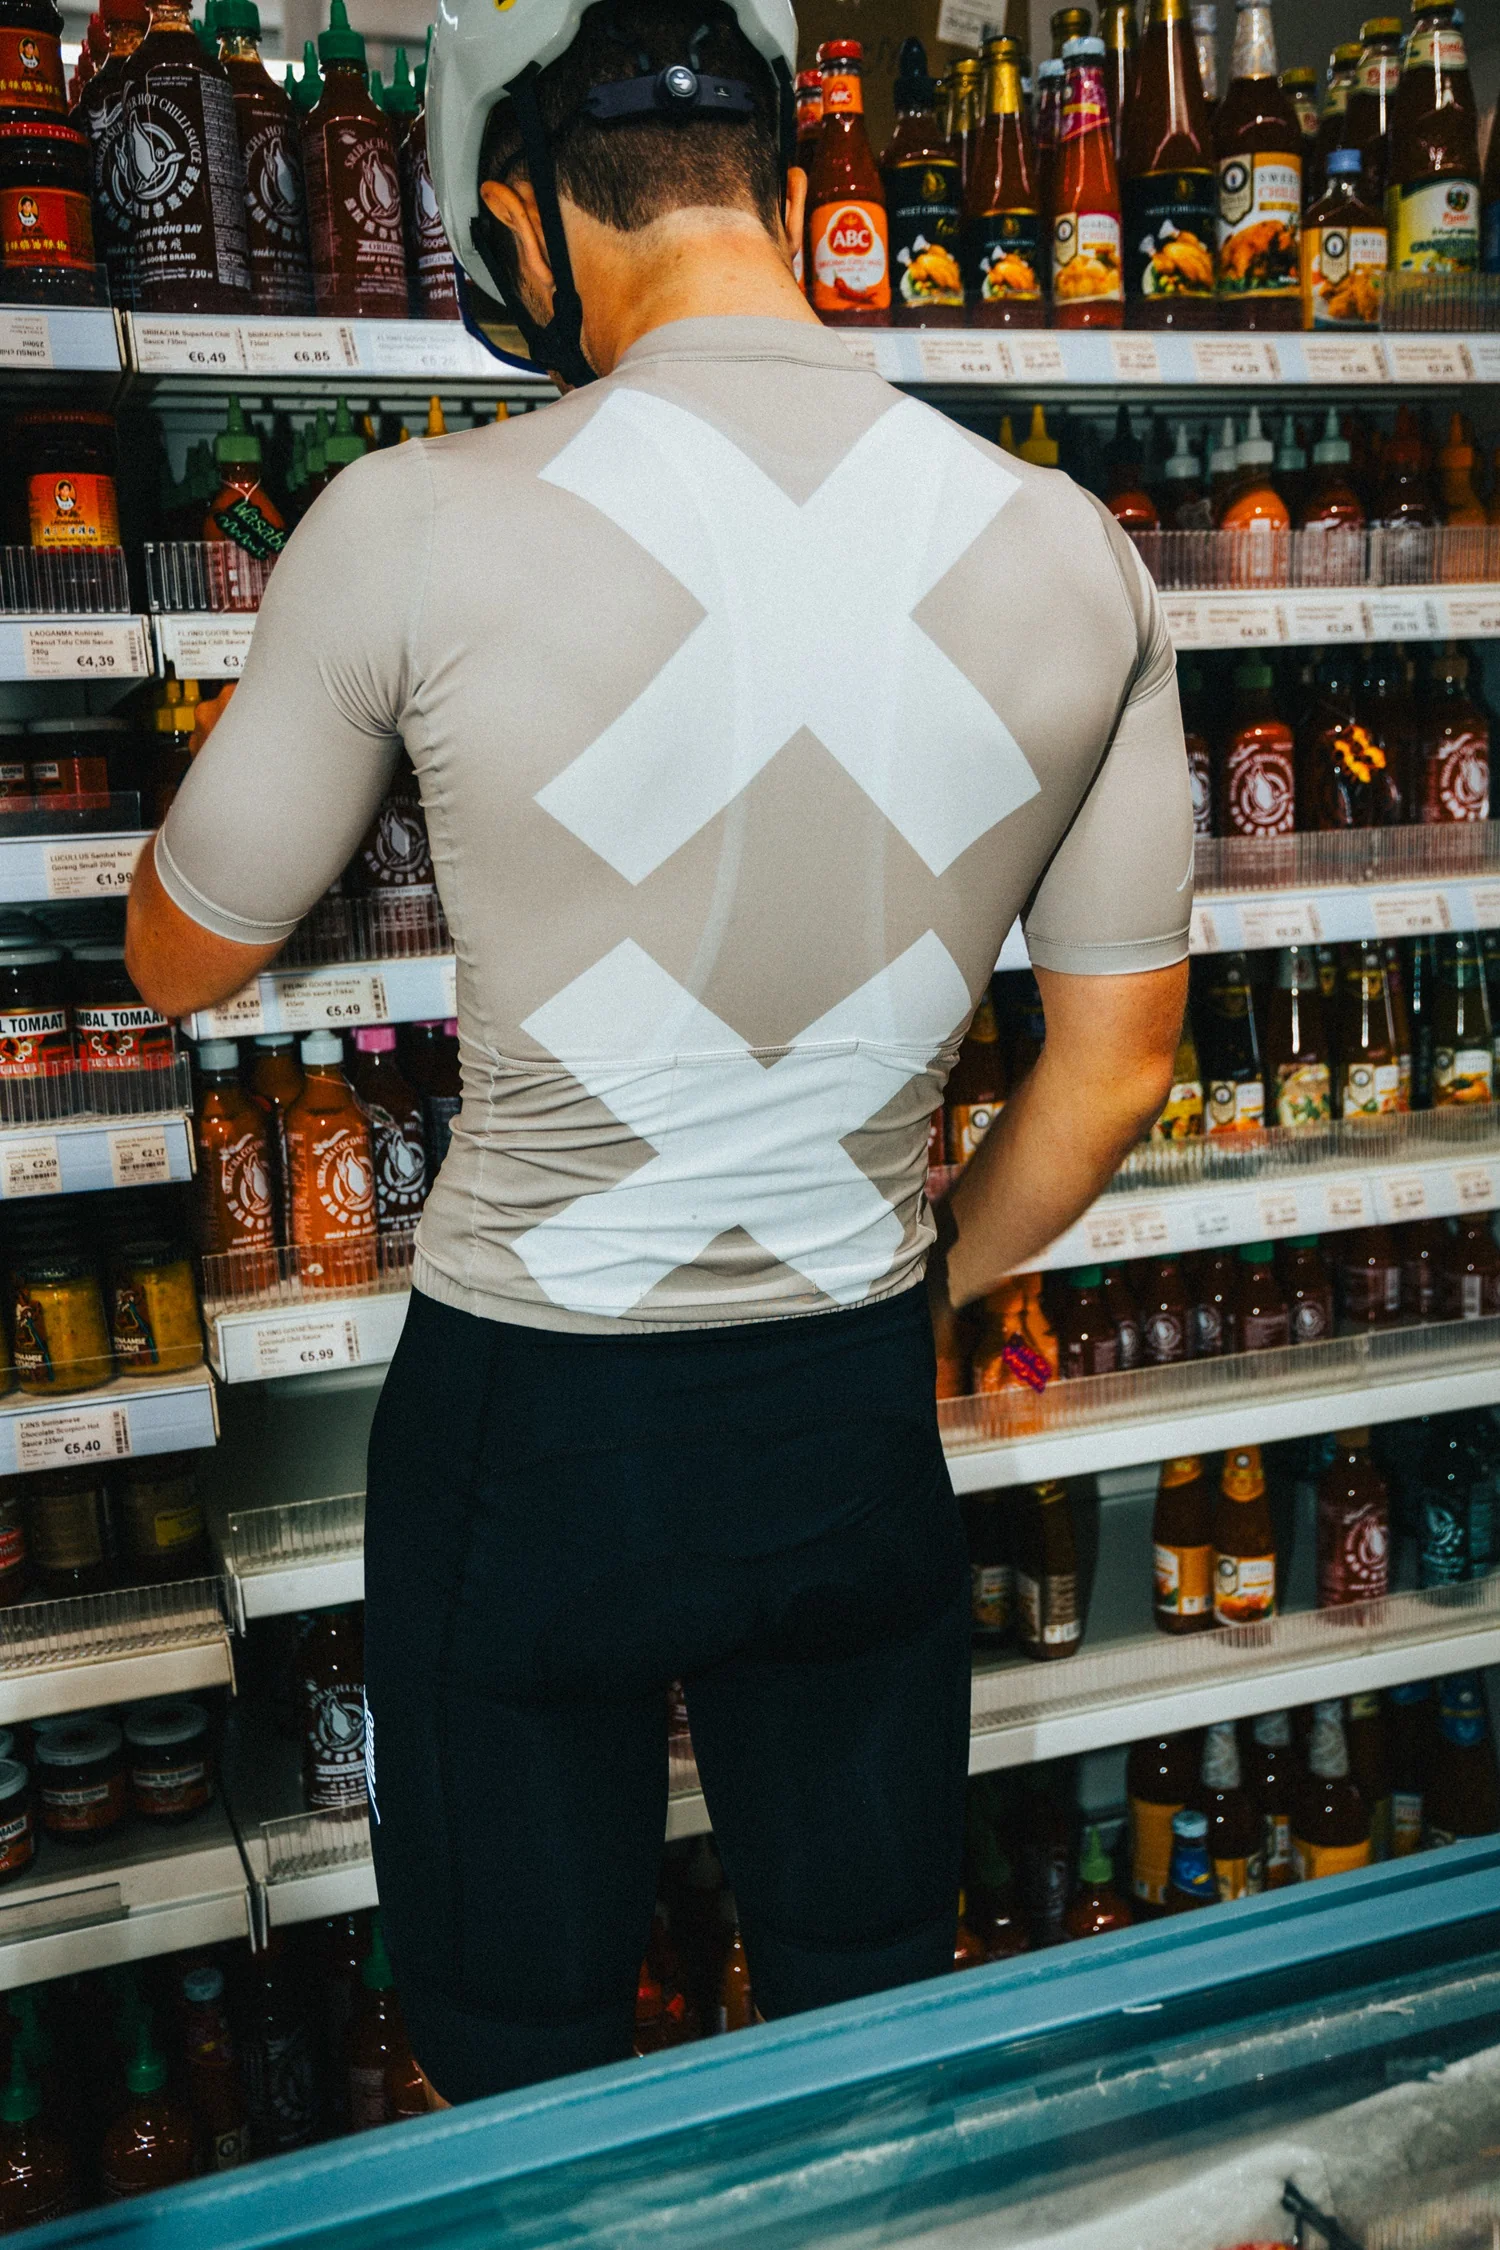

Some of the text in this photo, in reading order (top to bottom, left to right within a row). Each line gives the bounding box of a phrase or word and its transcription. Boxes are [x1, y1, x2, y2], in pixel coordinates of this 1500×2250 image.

[831, 91, 851, 102] ABC
[137, 93, 158, 107] HOT
[159, 98, 190, 130] CHILLI
[184, 127, 202, 164] SAUCE
[184, 224, 202, 234] BAY
[833, 230, 870, 248] ABC
[170, 253, 196, 262] BRAND
[189, 351, 226, 364] €6,49
[294, 351, 330, 363] €6,85
[77, 656, 115, 668] €4,39
[223, 655, 247, 668] €3,
[96, 872, 133, 886] €1,99
[326, 1004, 361, 1017] €5,49
[10, 1013, 63, 1033] TOMAAT
[33, 1160, 57, 1169] €2,69
[300, 1349, 334, 1362] €5,99
[21, 1429, 54, 1439] Chocolate
[64, 1440, 101, 1454] €5,40
